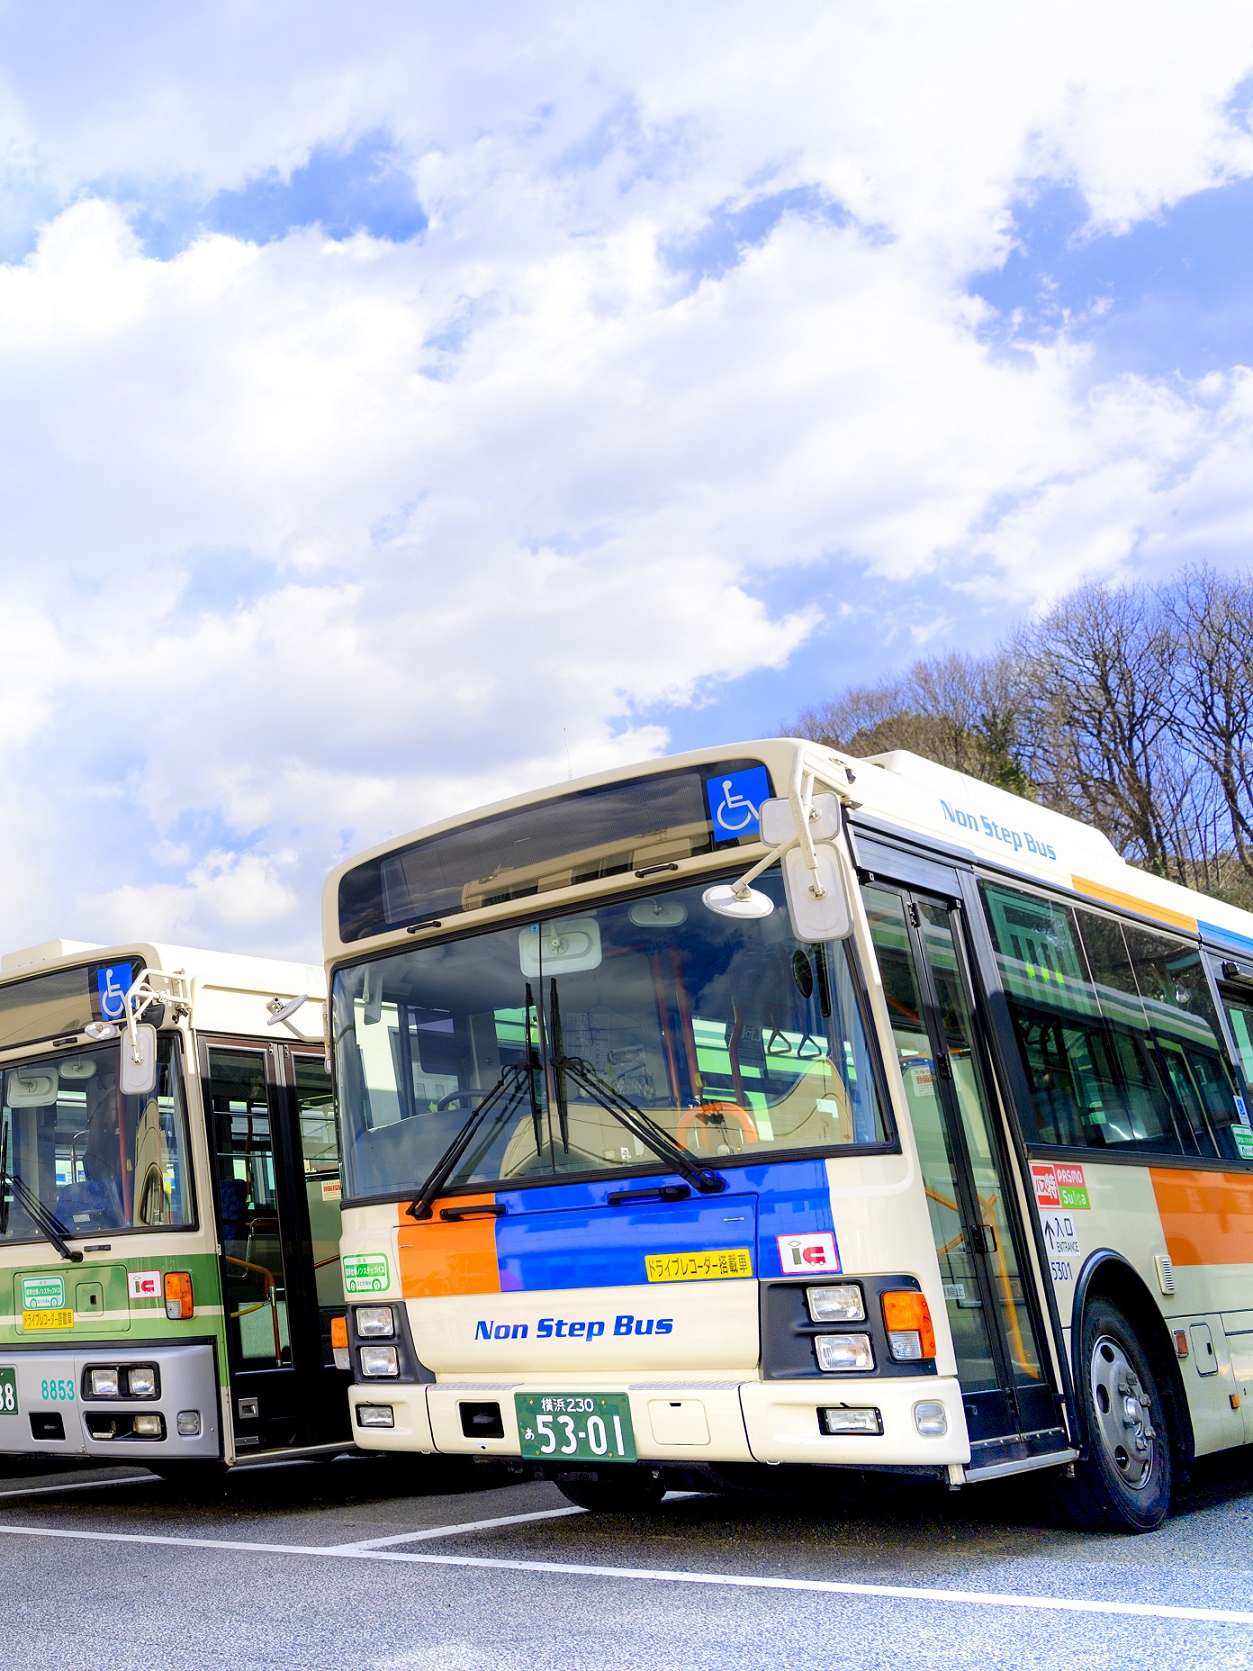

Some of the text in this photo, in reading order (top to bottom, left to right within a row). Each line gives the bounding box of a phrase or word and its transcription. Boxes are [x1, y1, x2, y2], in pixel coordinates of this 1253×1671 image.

[939, 799, 1057, 861] Non Step Bus
[1057, 1169, 1083, 1184] PASMO
[1062, 1189, 1087, 1205] Suica
[1054, 1217, 1074, 1237] 入口
[1056, 1241, 1080, 1253] ENTRANCE
[648, 1253, 748, 1279] ドライブレコーダー搭載車
[1051, 1261, 1073, 1281] 5301
[475, 1314, 674, 1342] Non Step Bus
[41, 1379, 75, 1401] 8853
[541, 1398, 594, 1413] 横浜230
[525, 1414, 625, 1456] あ 53-01
